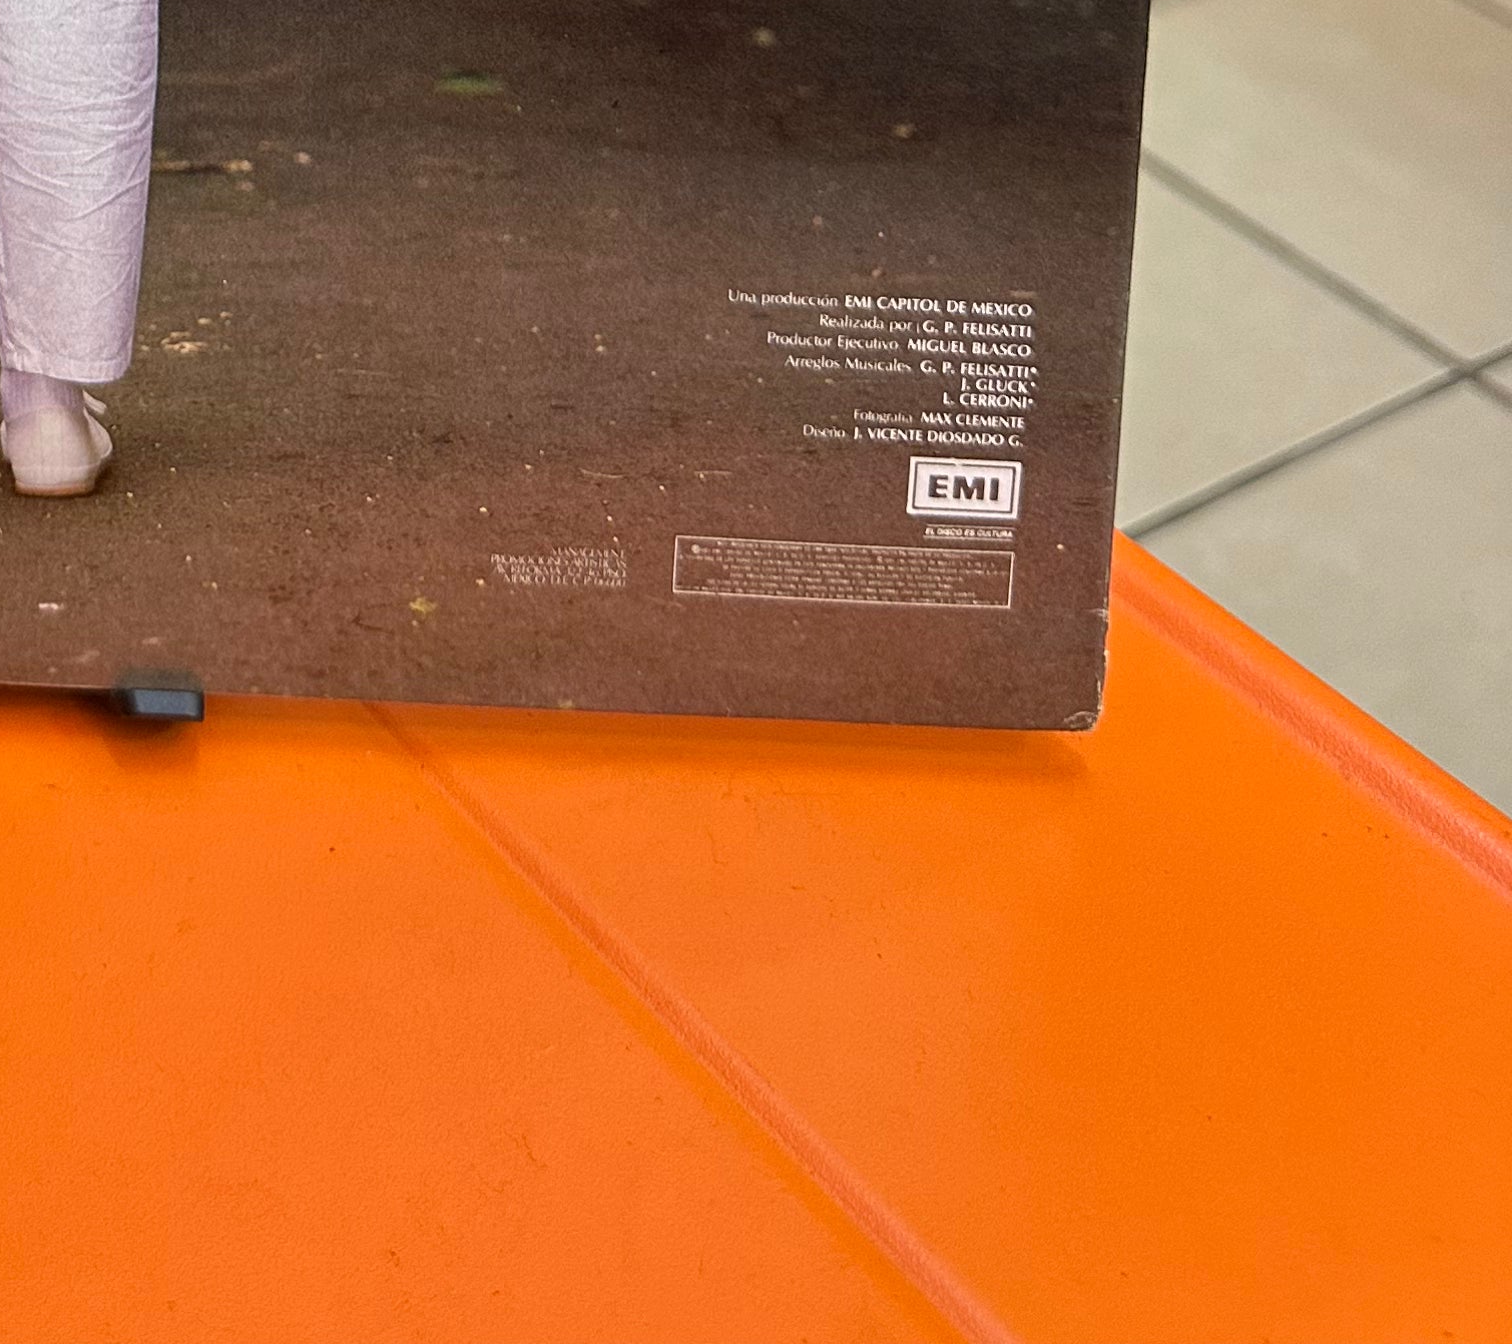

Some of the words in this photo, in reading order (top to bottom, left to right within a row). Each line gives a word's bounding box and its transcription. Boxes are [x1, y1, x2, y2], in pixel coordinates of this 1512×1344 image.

[727, 288, 758, 305] Una
[760, 290, 839, 311] producción
[843, 294, 873, 309] EMI
[876, 295, 942, 313] CAPITOL
[945, 299, 968, 314] DE
[970, 300, 1034, 318] MEXICO
[818, 313, 885, 331] Realizada
[921, 319, 941, 335] G.
[943, 321, 959, 335] P.
[961, 322, 1033, 339] FELISATTI
[766, 330, 834, 348] Productor
[836, 334, 900, 352] Ejecutivo
[906, 338, 967, 355] MIGUEL
[971, 341, 1033, 358] BLASCO
[783, 353, 841, 372] Arreglos
[843, 356, 912, 373] Musicales
[919, 359, 938, 375] G.
[941, 362, 957, 376] P.
[920, 411, 952, 427] MAX
[954, 413, 1026, 430] CLEMENTE
[866, 427, 924, 443] VICENTE
[926, 429, 1005, 446] DIOSDADO
[1007, 433, 1025, 448] G.
[927, 473, 1001, 502] EMI
